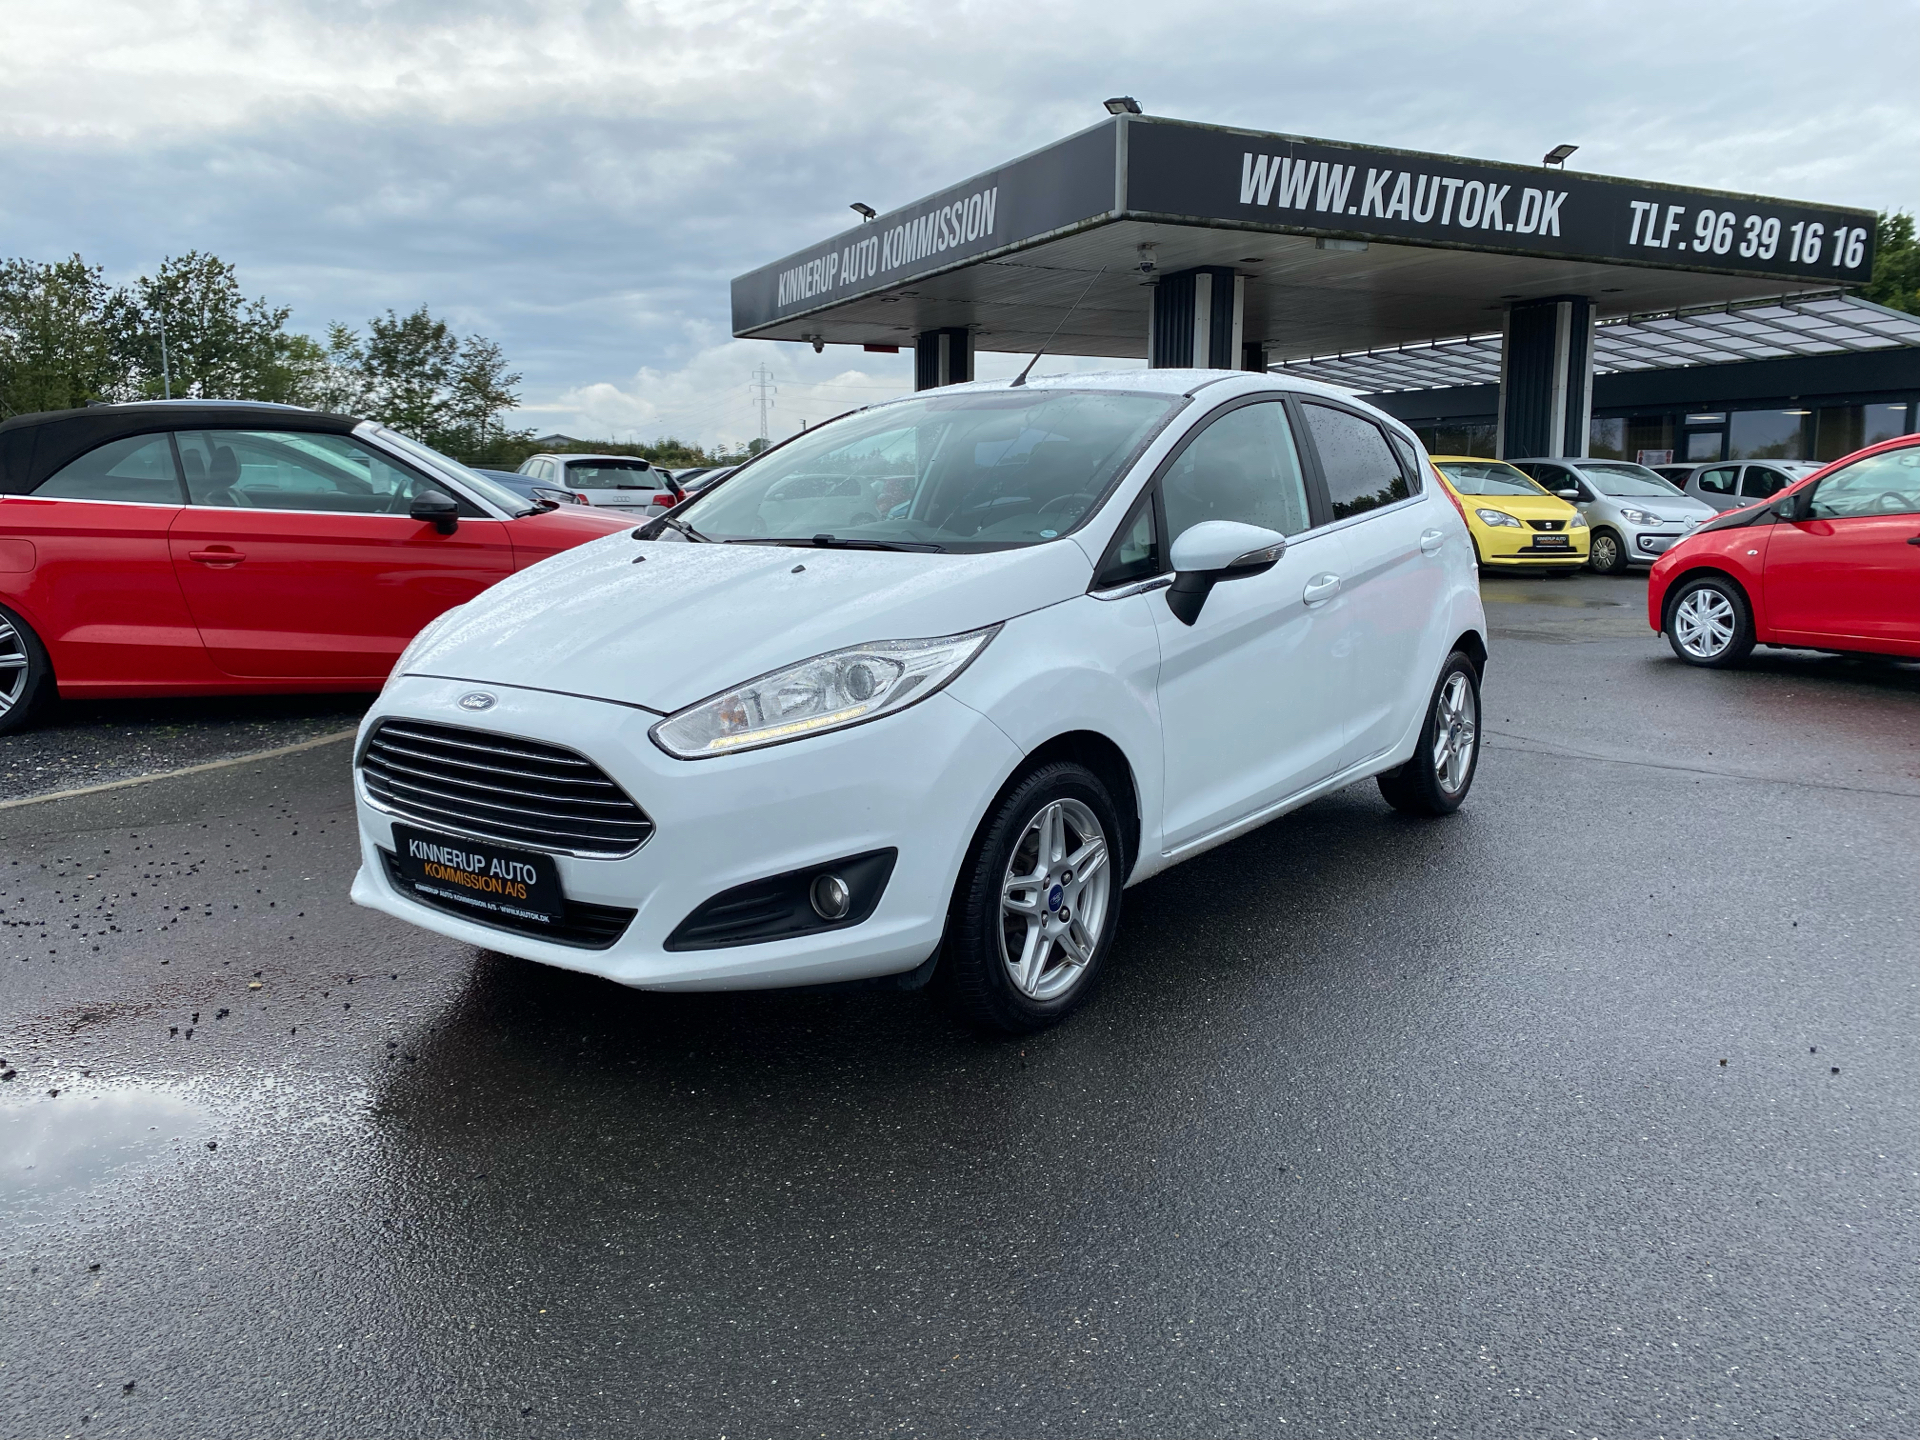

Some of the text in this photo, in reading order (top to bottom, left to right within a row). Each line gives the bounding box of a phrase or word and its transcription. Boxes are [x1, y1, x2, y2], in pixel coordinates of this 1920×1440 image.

[1239, 152, 1569, 237] WWW.KAUTOK.DK
[778, 187, 998, 307] KINNERUP AUTO KOMMISSION
[1692, 209, 1736, 255] 96
[1739, 214, 1782, 260] 39
[1789, 221, 1825, 264] 16
[1832, 226, 1867, 269] 16
[463, 695, 489, 707] Ford
[409, 838, 537, 885] KINNERUP AUTO
[424, 862, 527, 899] KOMMISSION A/S
